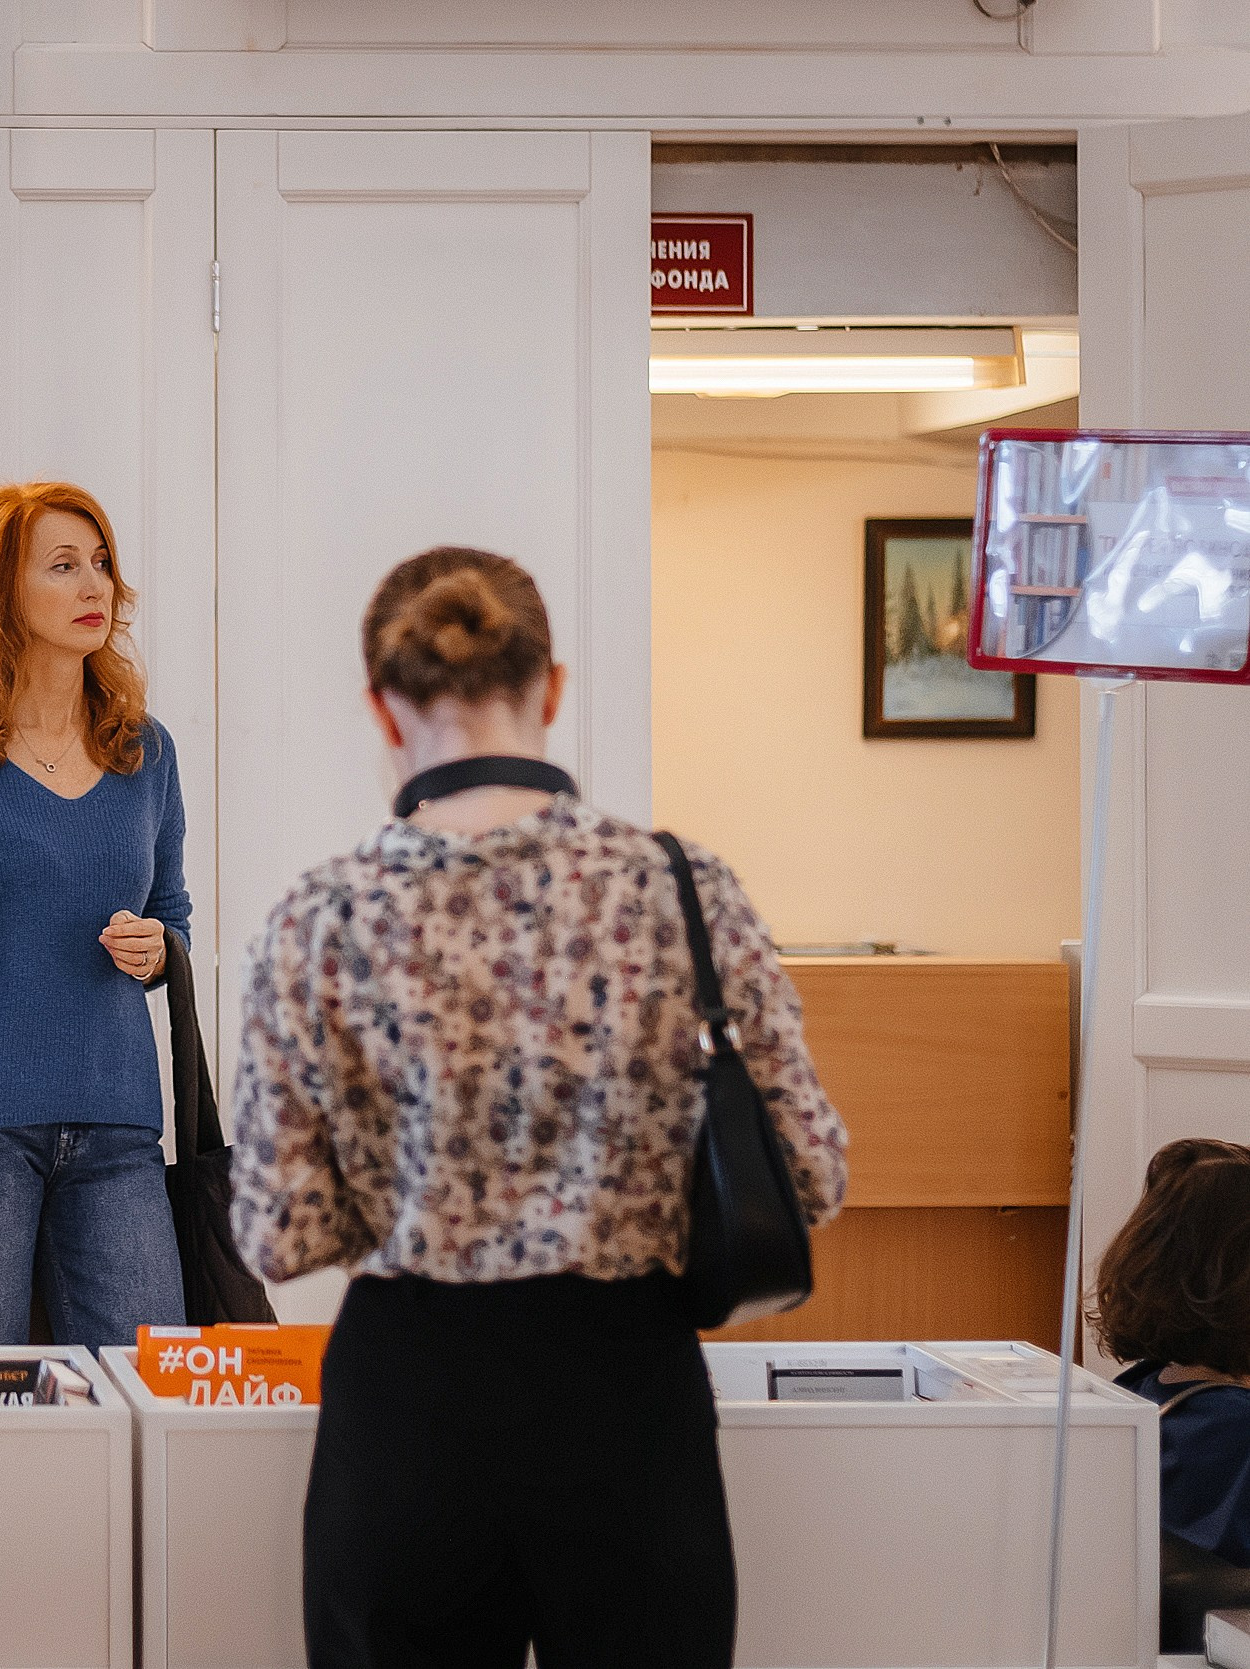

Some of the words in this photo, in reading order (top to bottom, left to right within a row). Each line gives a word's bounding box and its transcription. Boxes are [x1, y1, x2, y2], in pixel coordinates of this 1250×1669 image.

[651, 269, 730, 293] ФОНДА
[158, 1345, 243, 1376] #ОН
[188, 1374, 303, 1406] ЛАЙФ
